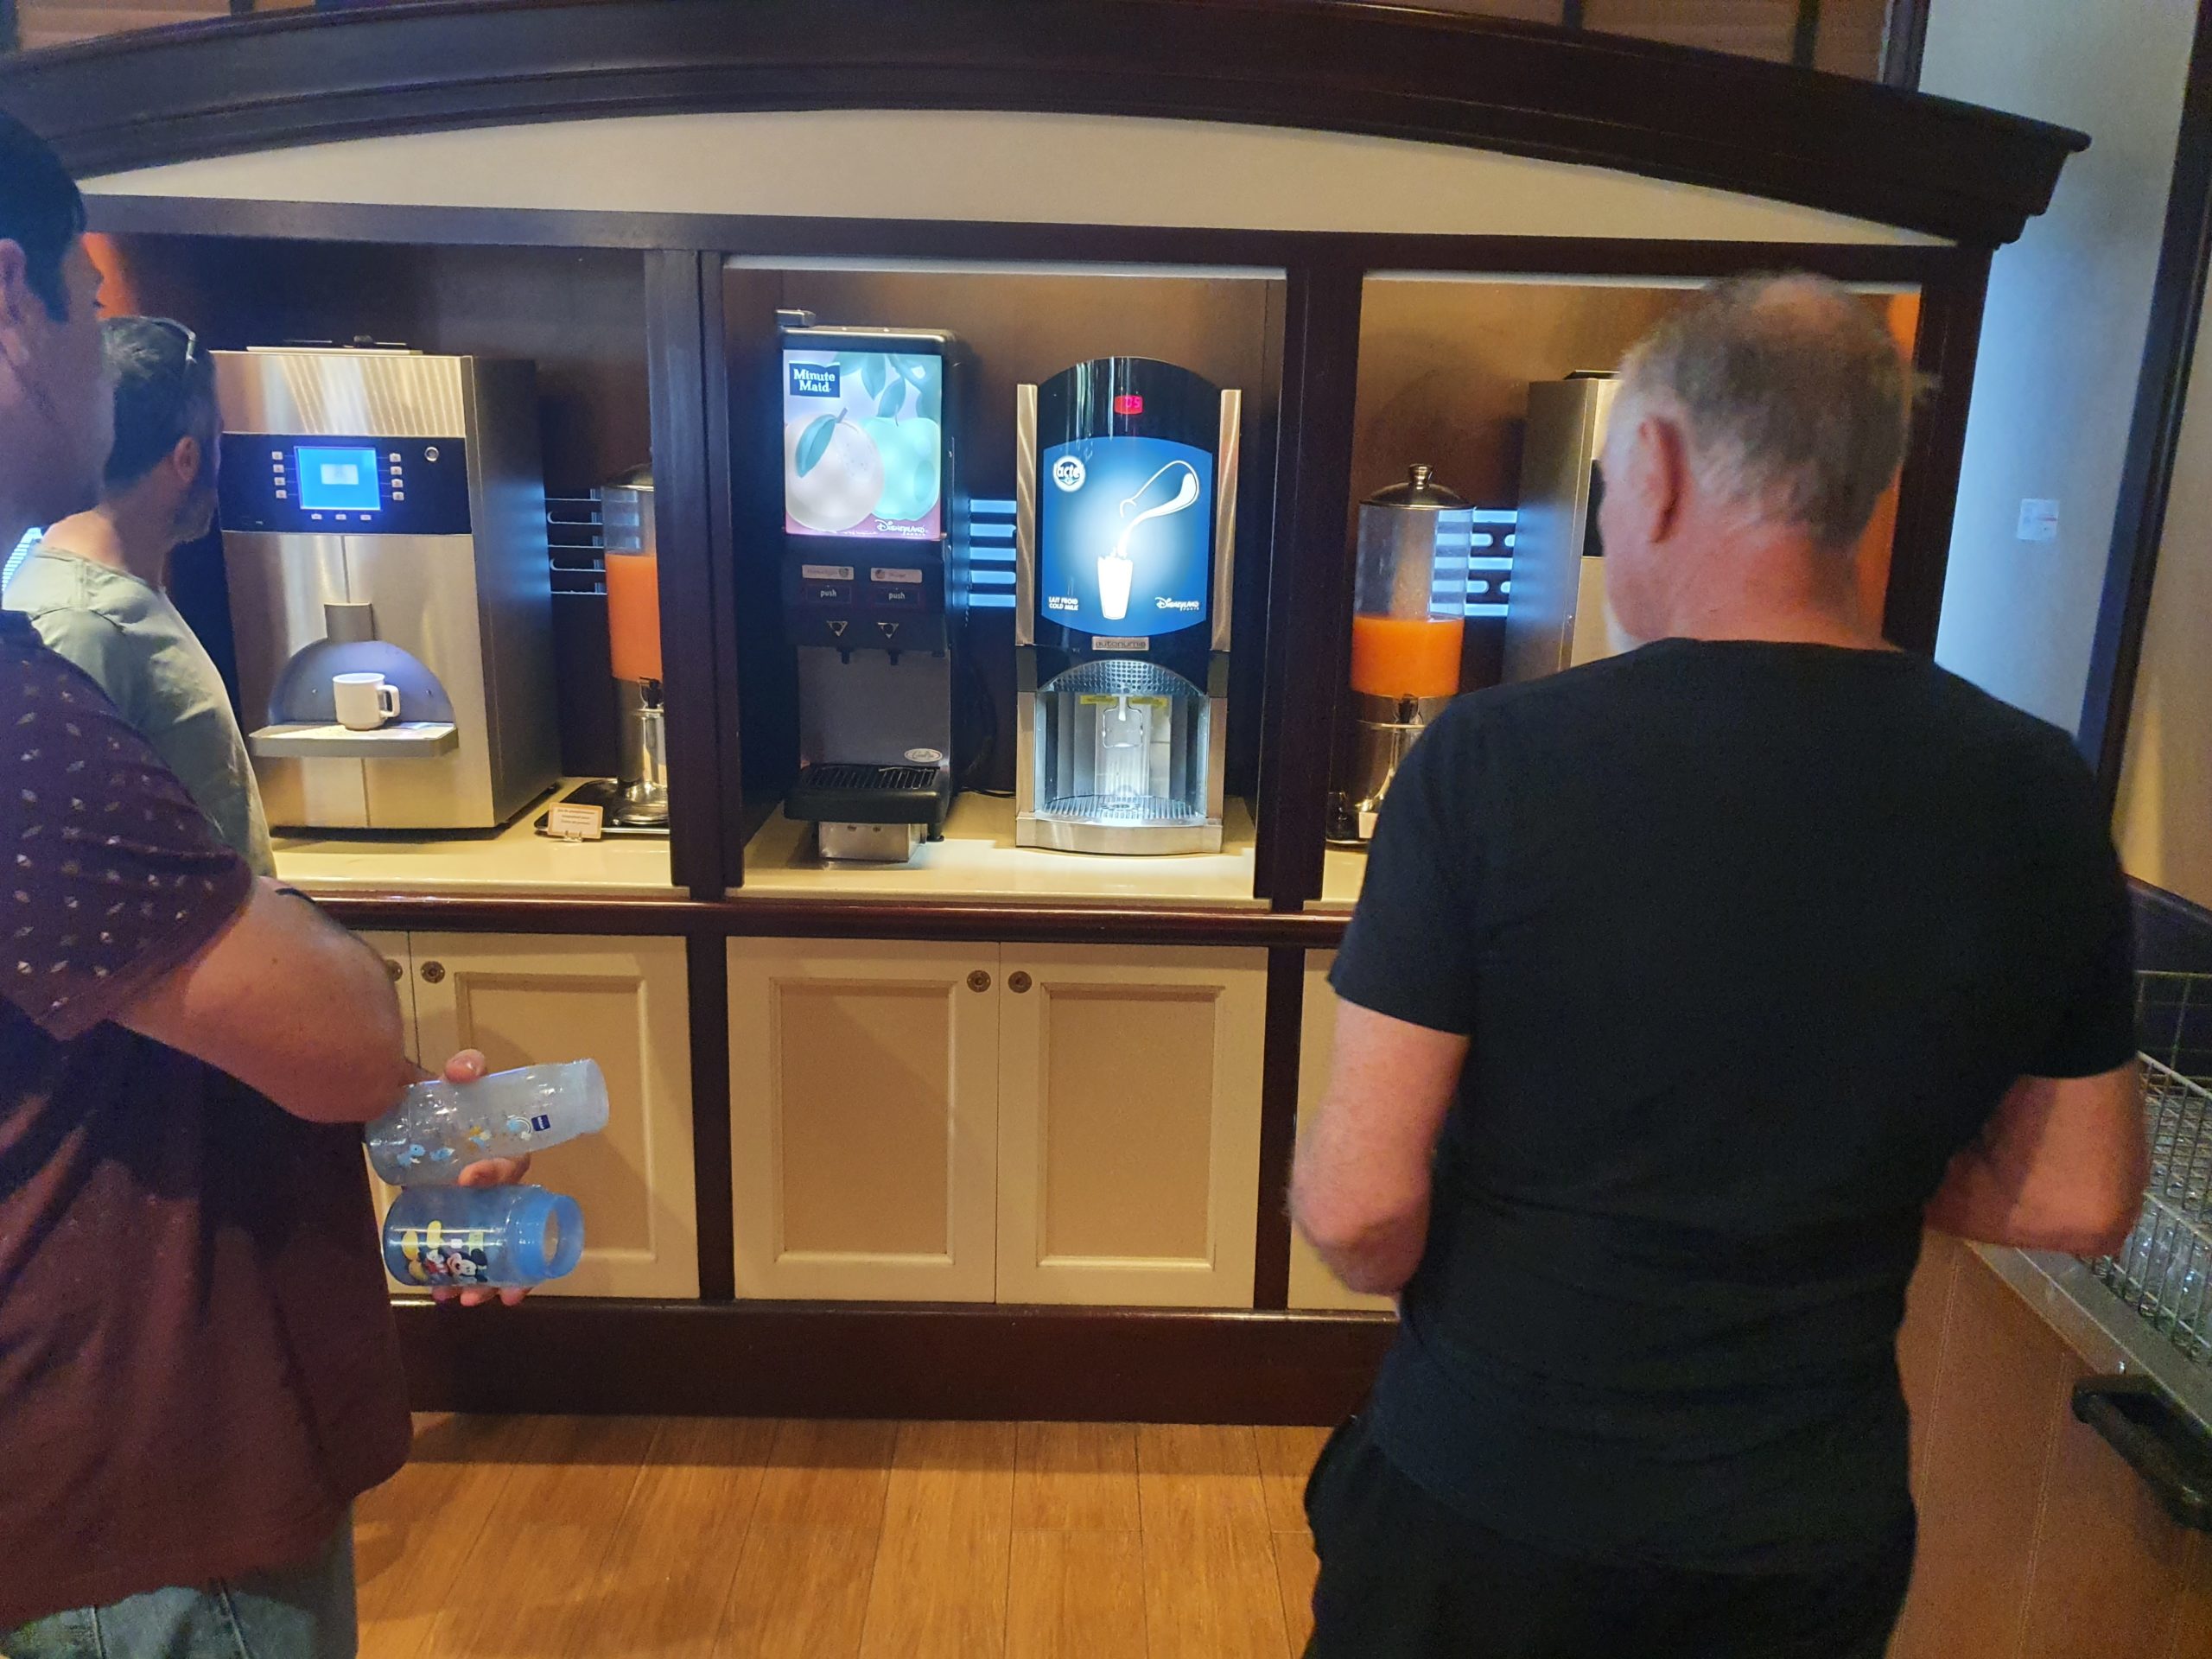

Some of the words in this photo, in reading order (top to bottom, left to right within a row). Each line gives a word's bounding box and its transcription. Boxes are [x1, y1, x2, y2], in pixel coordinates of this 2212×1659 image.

[793, 368, 836, 382] Minute
[799, 379, 830, 393] Maid
[820, 588, 837, 598] push
[888, 591, 906, 601] push
